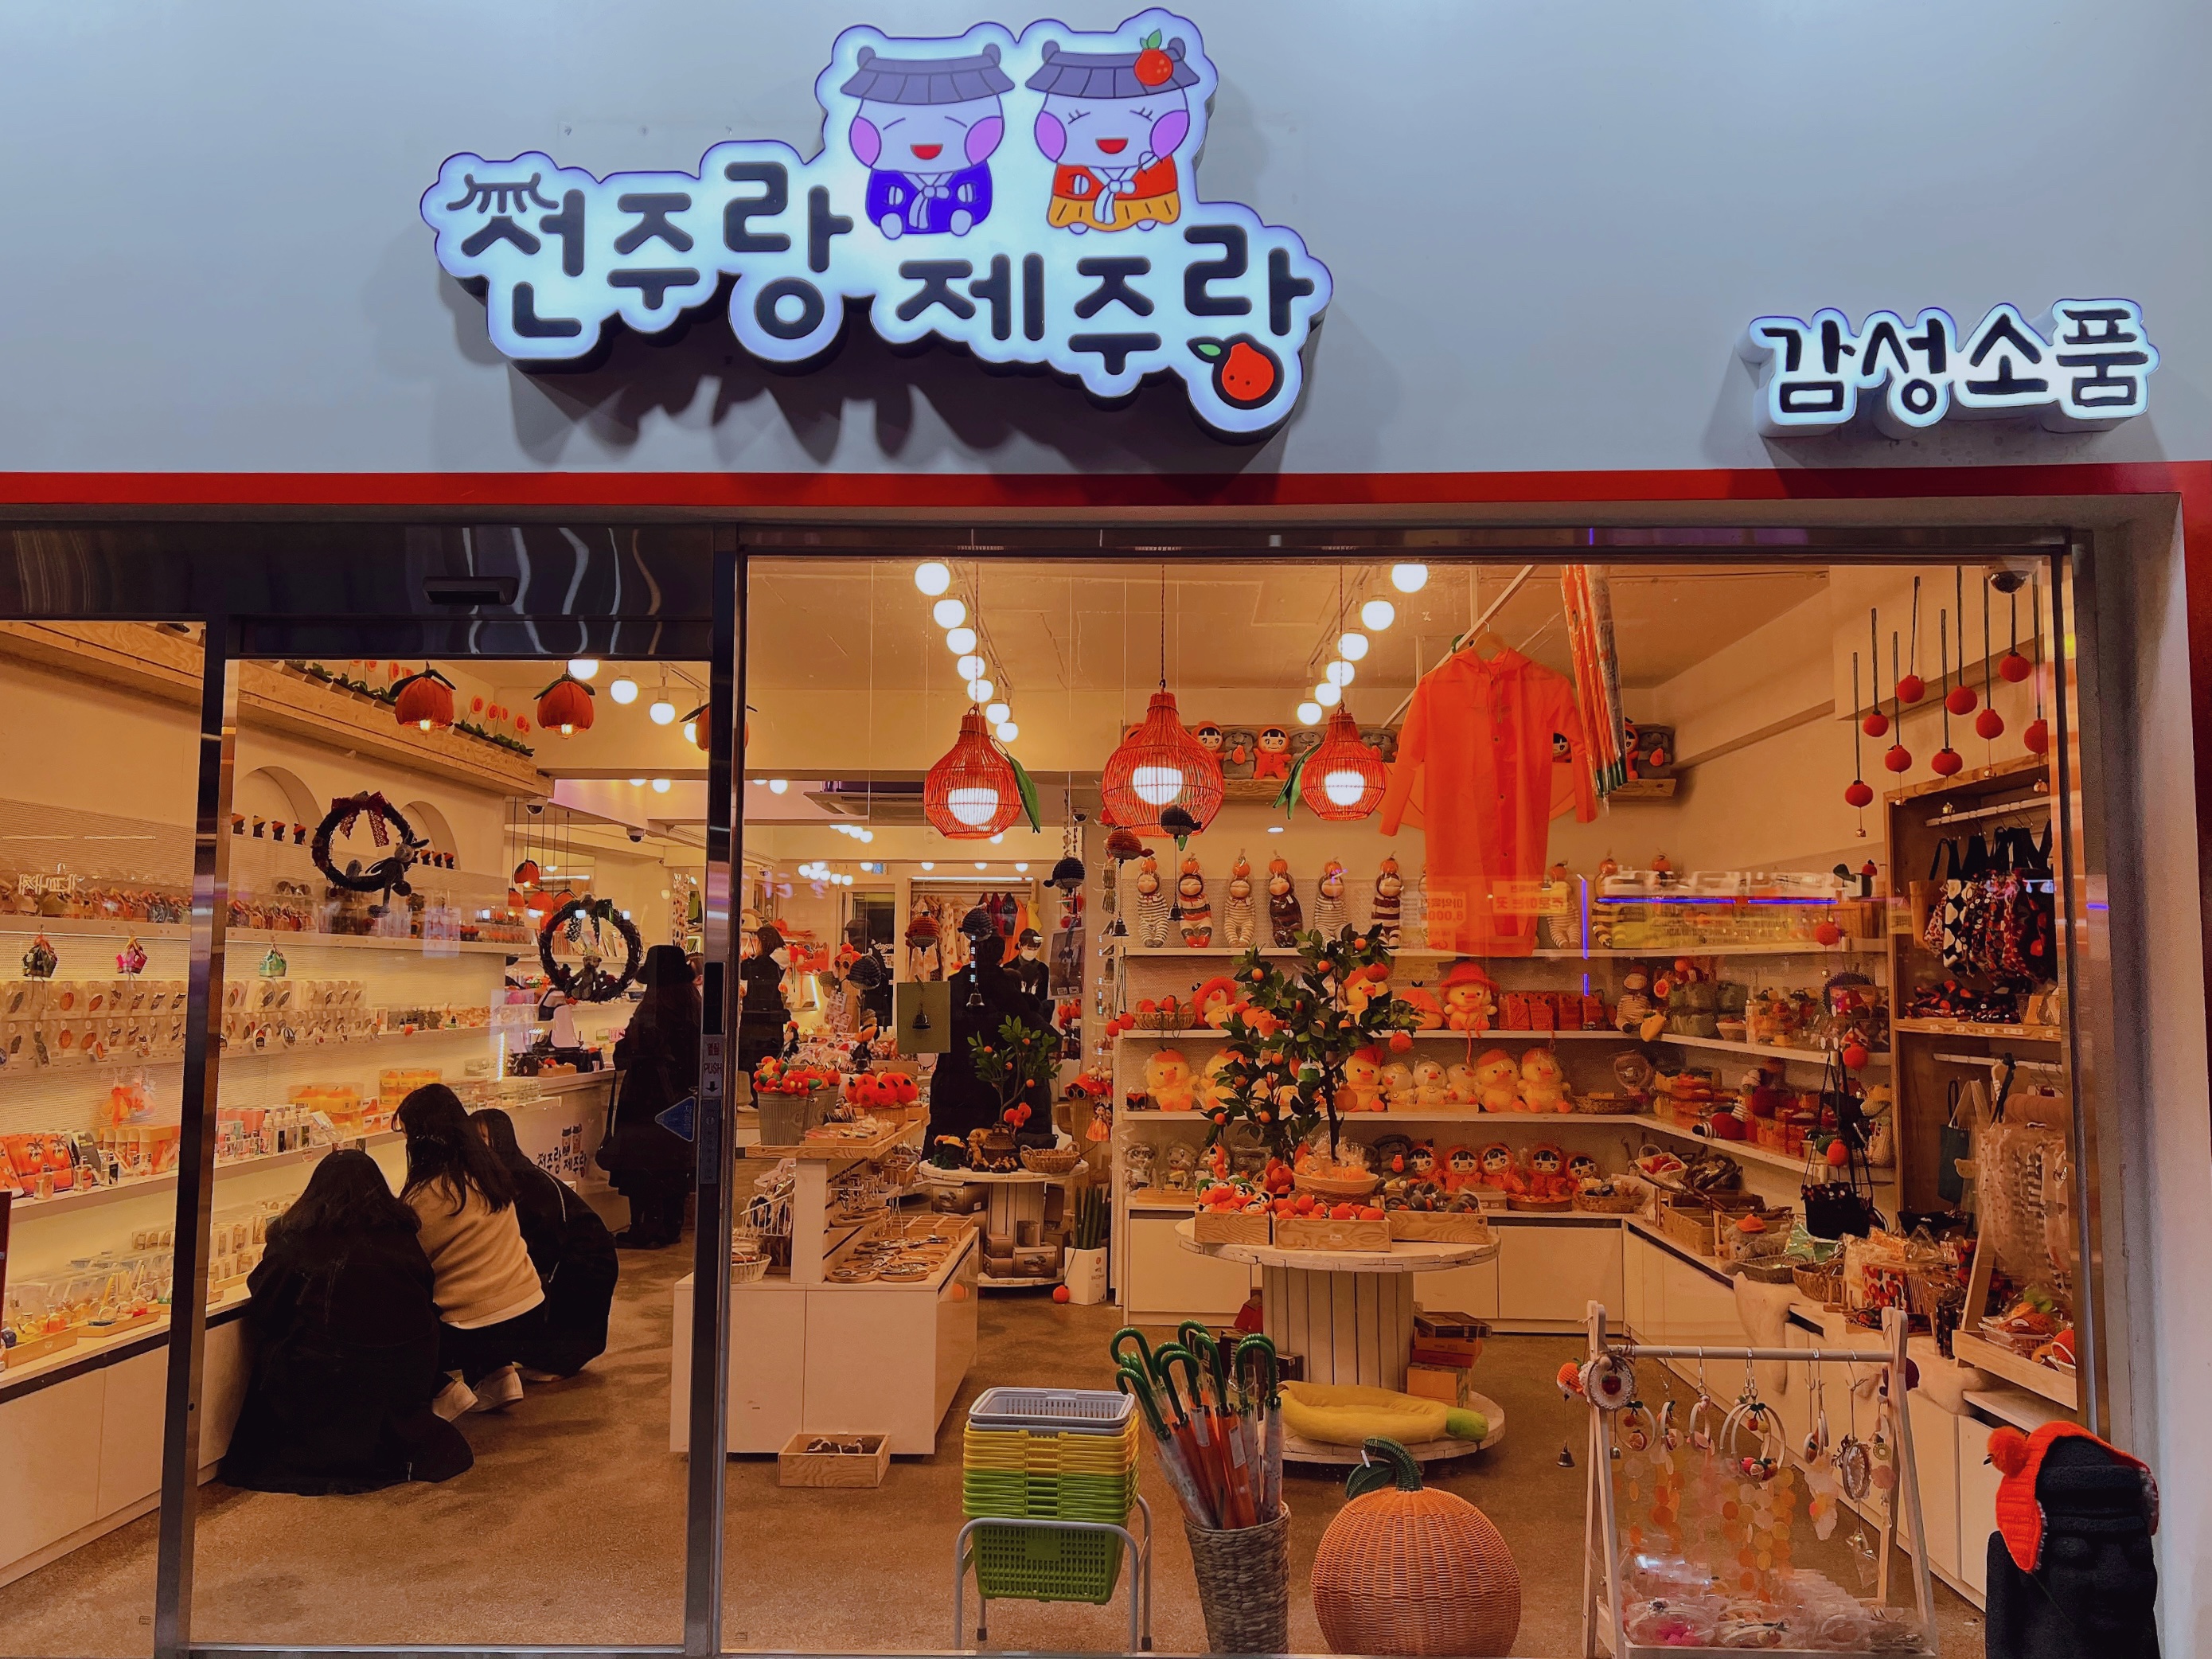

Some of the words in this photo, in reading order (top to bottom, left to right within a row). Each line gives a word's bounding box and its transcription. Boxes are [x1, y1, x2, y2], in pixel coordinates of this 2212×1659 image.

[447, 162, 853, 341] 전주랑
[896, 224, 1315, 410] 제주랑
[1761, 308, 2148, 414] 감성소품
[703, 1062, 723, 1075] PUSH
